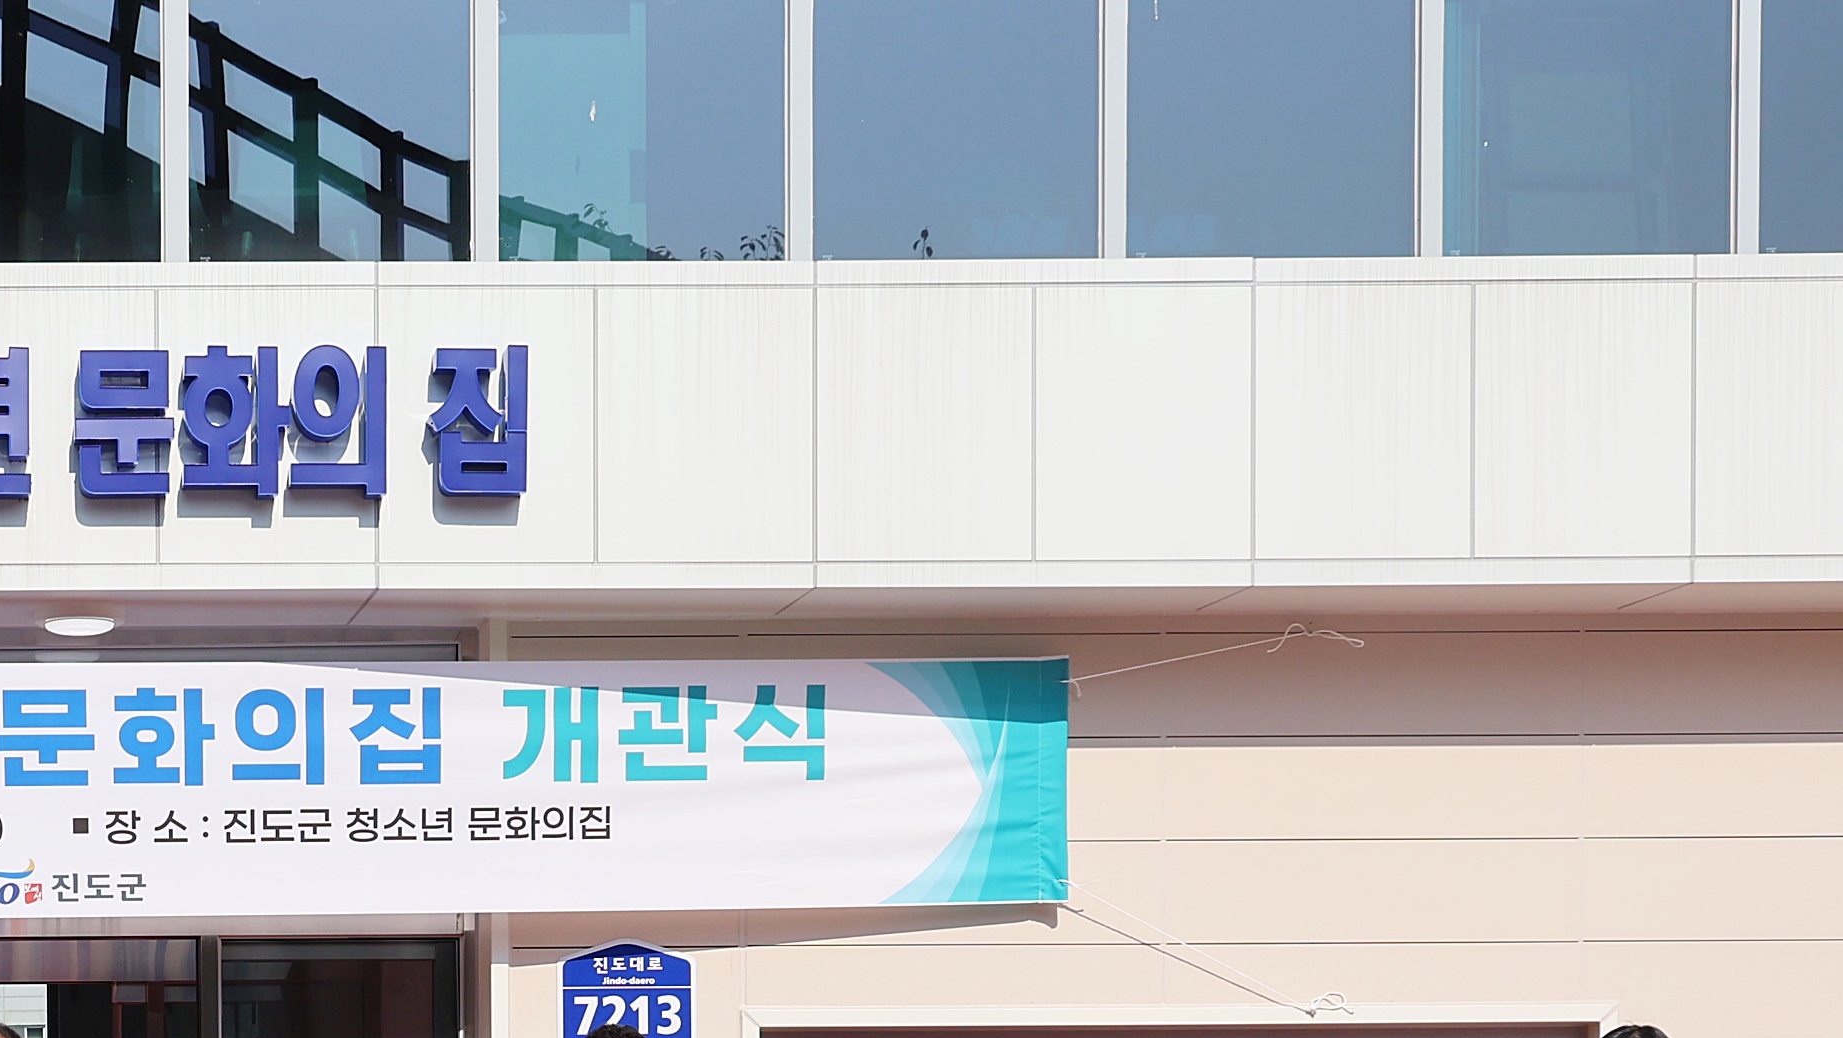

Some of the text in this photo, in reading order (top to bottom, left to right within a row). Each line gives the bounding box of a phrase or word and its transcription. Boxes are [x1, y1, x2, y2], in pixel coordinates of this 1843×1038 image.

[74, 345, 387, 500] 문화의
[428, 345, 528, 497] 집
[502, 685, 826, 782] 개관식
[104, 809, 141, 844] 장
[223, 808, 332, 843] 진도군
[346, 807, 454, 842] 청소년
[468, 806, 612, 841] 문화의집
[51, 873, 147, 902] 진도군
[592, 956, 664, 975] 진도대로
[601, 976, 656, 985] Jindo-daero
[573, 994, 682, 1036] 7213
